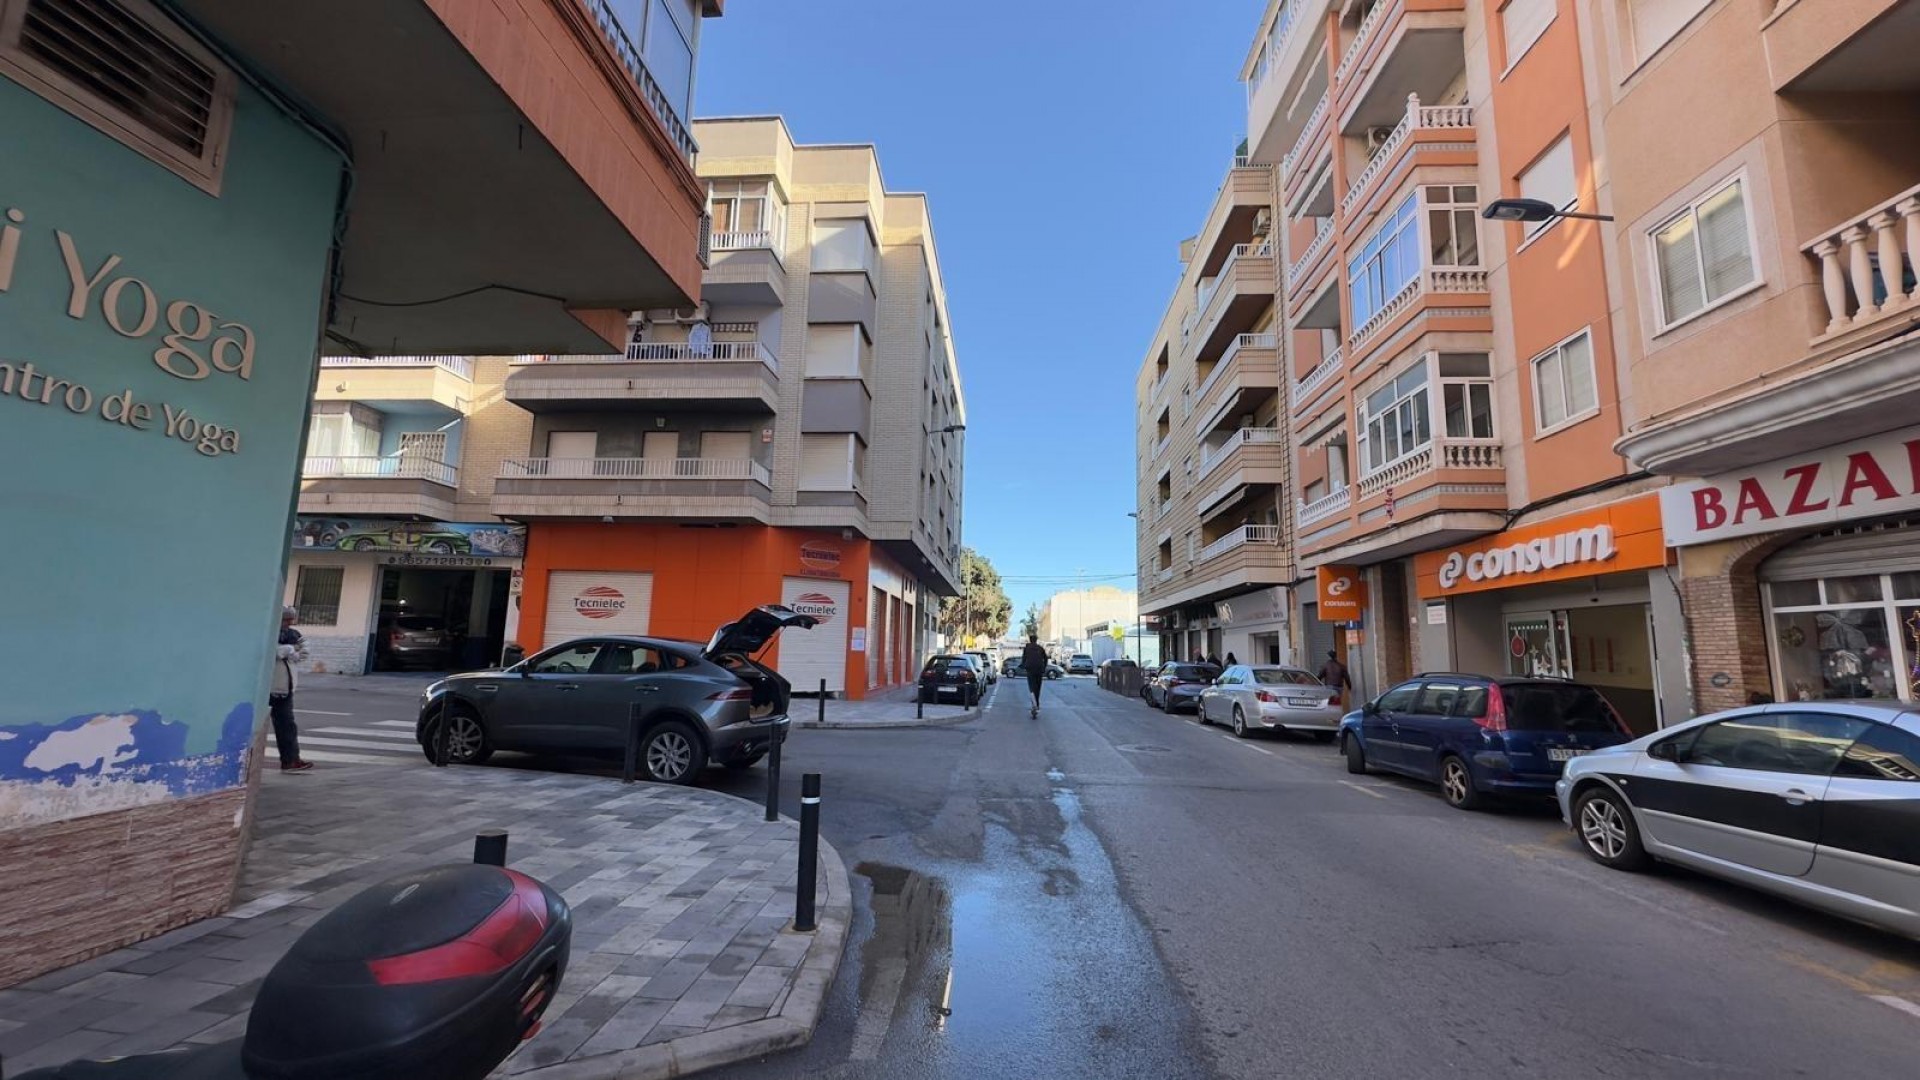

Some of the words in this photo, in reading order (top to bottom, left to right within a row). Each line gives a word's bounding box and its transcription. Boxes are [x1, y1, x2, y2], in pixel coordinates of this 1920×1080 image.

[54, 229, 256, 380] Yoga
[102, 389, 151, 430] de
[163, 403, 240, 457] Yoga
[1466, 524, 1615, 581] consum
[574, 597, 625, 608] Tecnielec
[790, 603, 837, 615] Tecnielec
